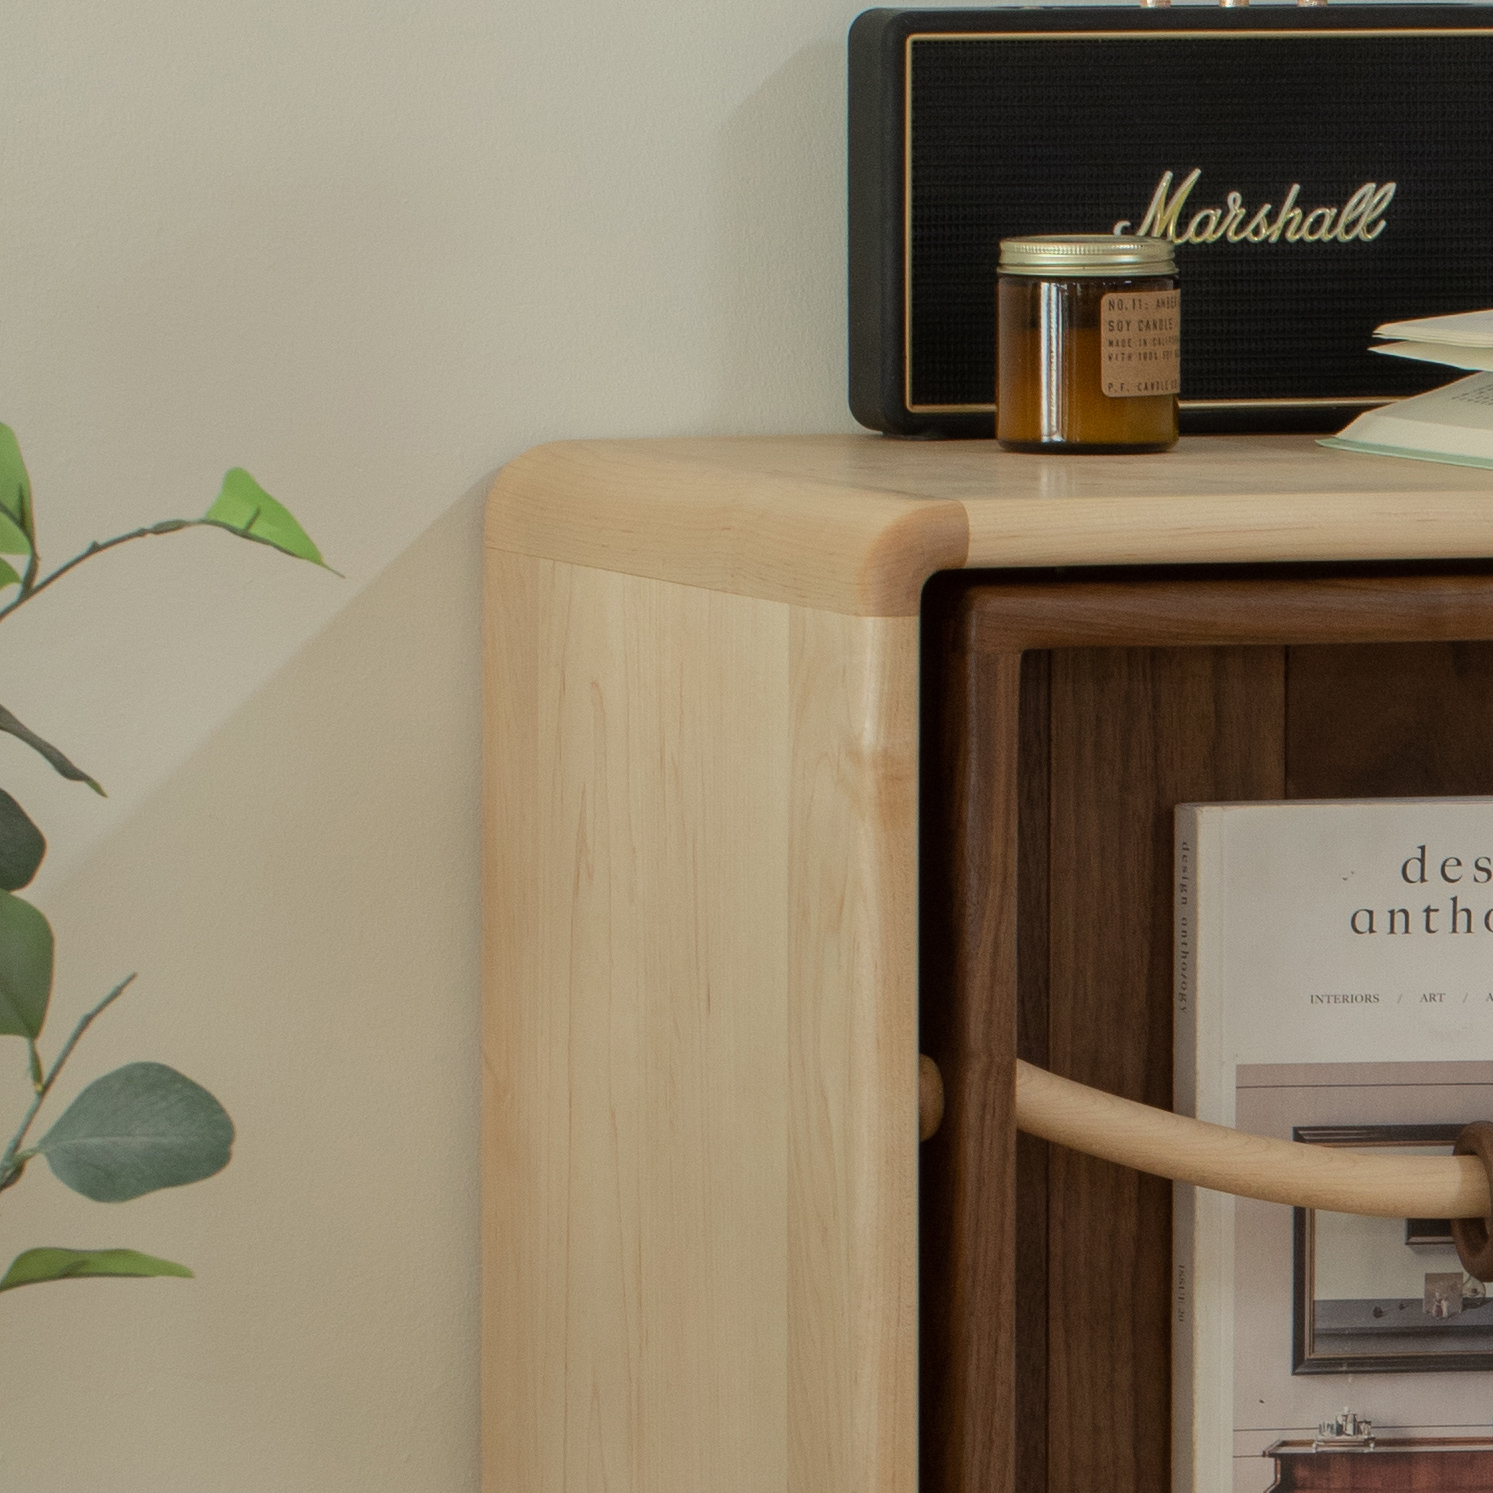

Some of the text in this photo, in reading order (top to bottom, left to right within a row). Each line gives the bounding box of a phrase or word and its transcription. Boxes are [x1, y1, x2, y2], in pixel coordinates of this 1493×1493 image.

[1113, 167, 1398, 245] Marshall
[1108, 317, 1173, 333] SOY CANDLE
[1108, 338, 1132, 348] MADE
[1139, 337, 1148, 347] IN
[1309, 993, 1380, 1004] INTERIORS
[1419, 992, 1446, 1004] ART
